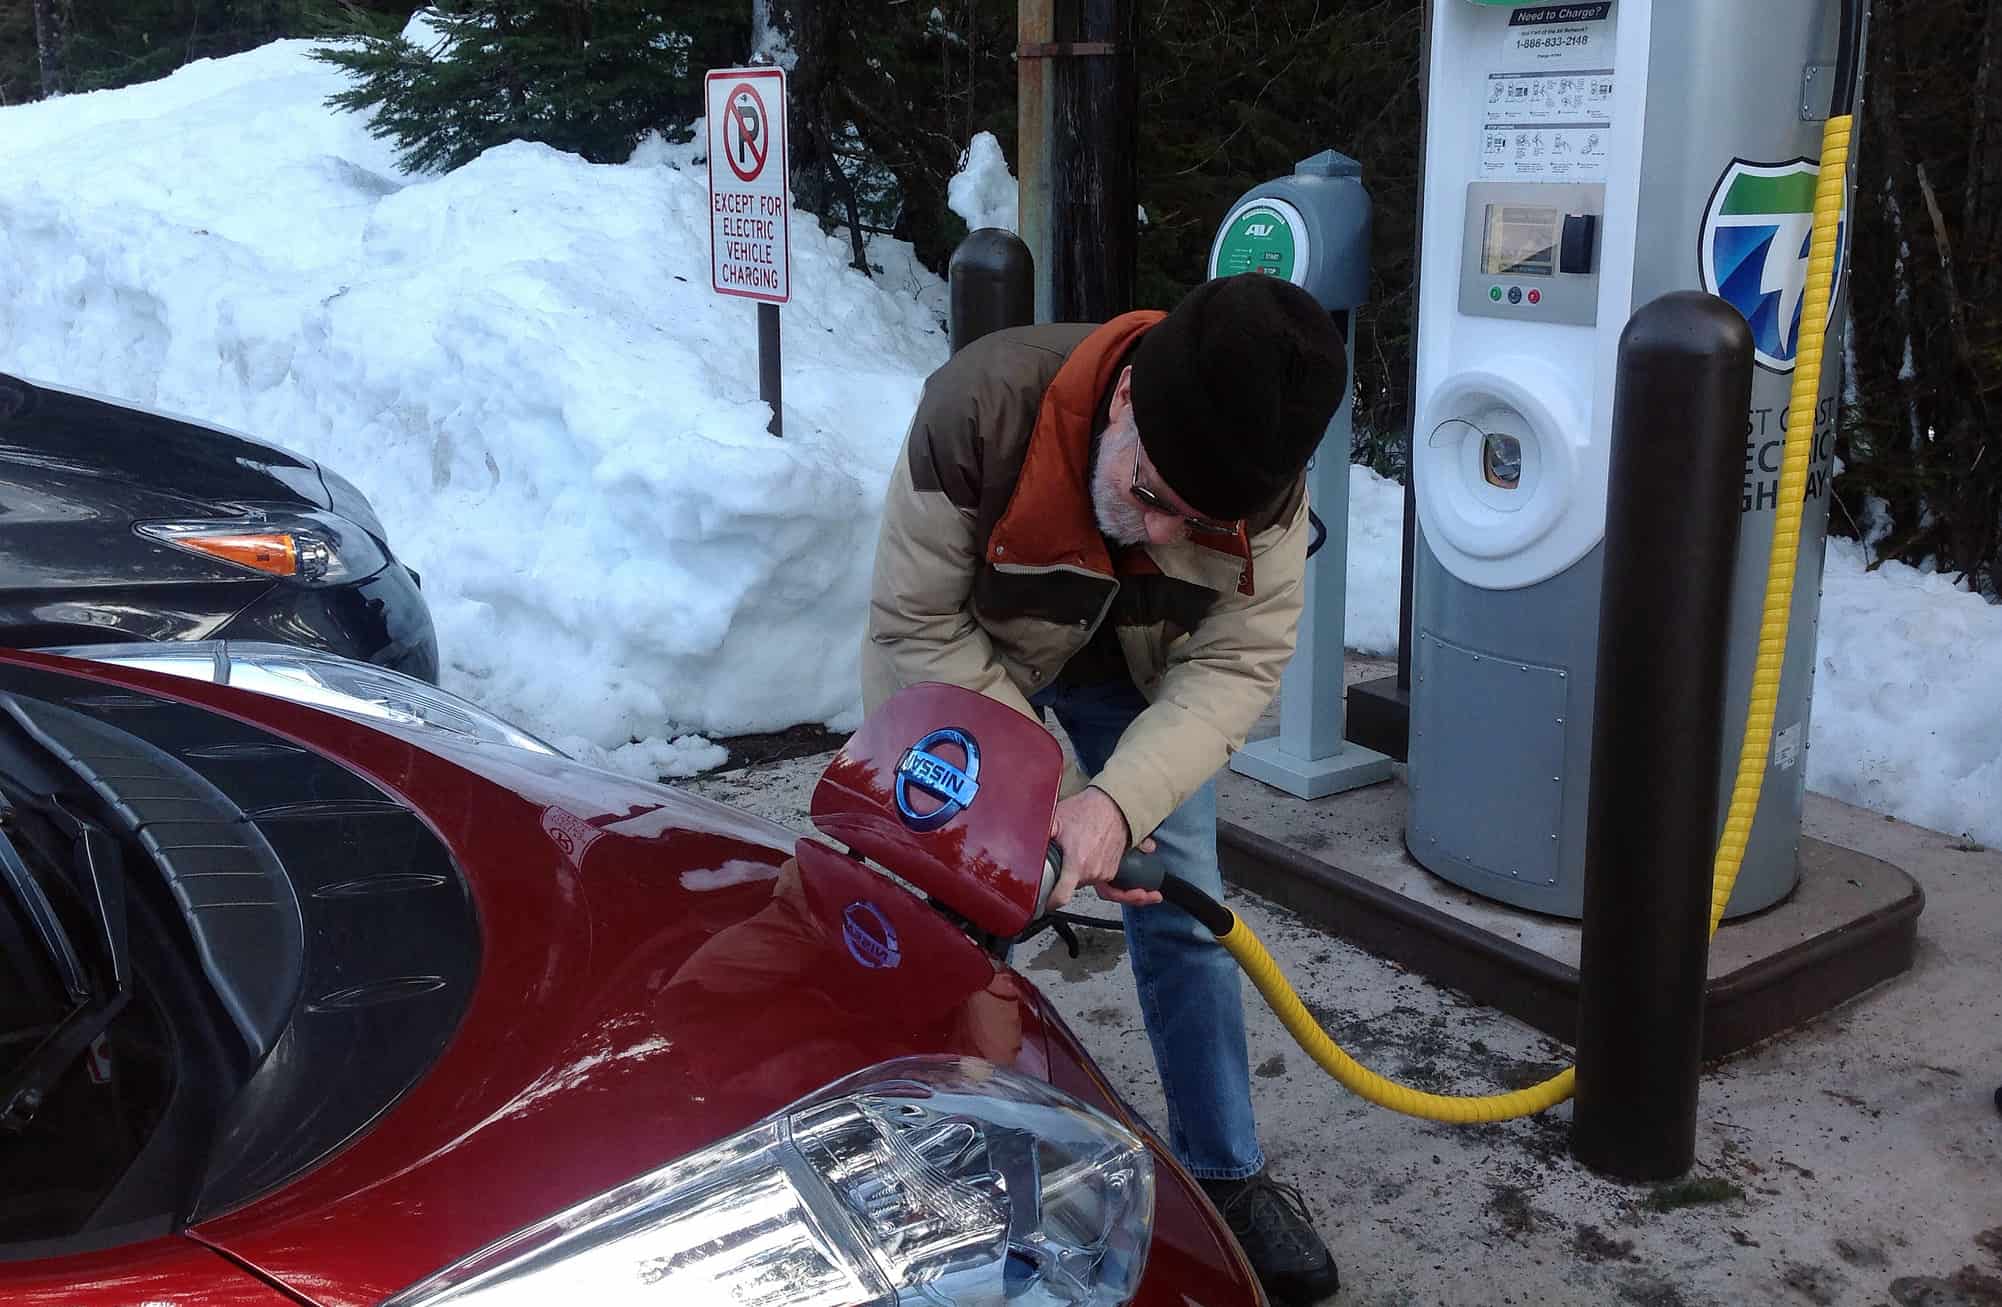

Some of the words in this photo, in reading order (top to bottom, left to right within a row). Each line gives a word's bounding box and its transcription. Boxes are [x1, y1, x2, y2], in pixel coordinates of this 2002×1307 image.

[1518, 9, 1544, 22] Need
[1546, 9, 1557, 20] to
[1559, 6, 1602, 21] Charge?
[714, 193, 754, 214] EXCEPT
[760, 196, 782, 217] FOR
[723, 217, 774, 241] ELECTRIC
[726, 240, 773, 264] VEHICLE
[722, 263, 778, 289] CHARGING
